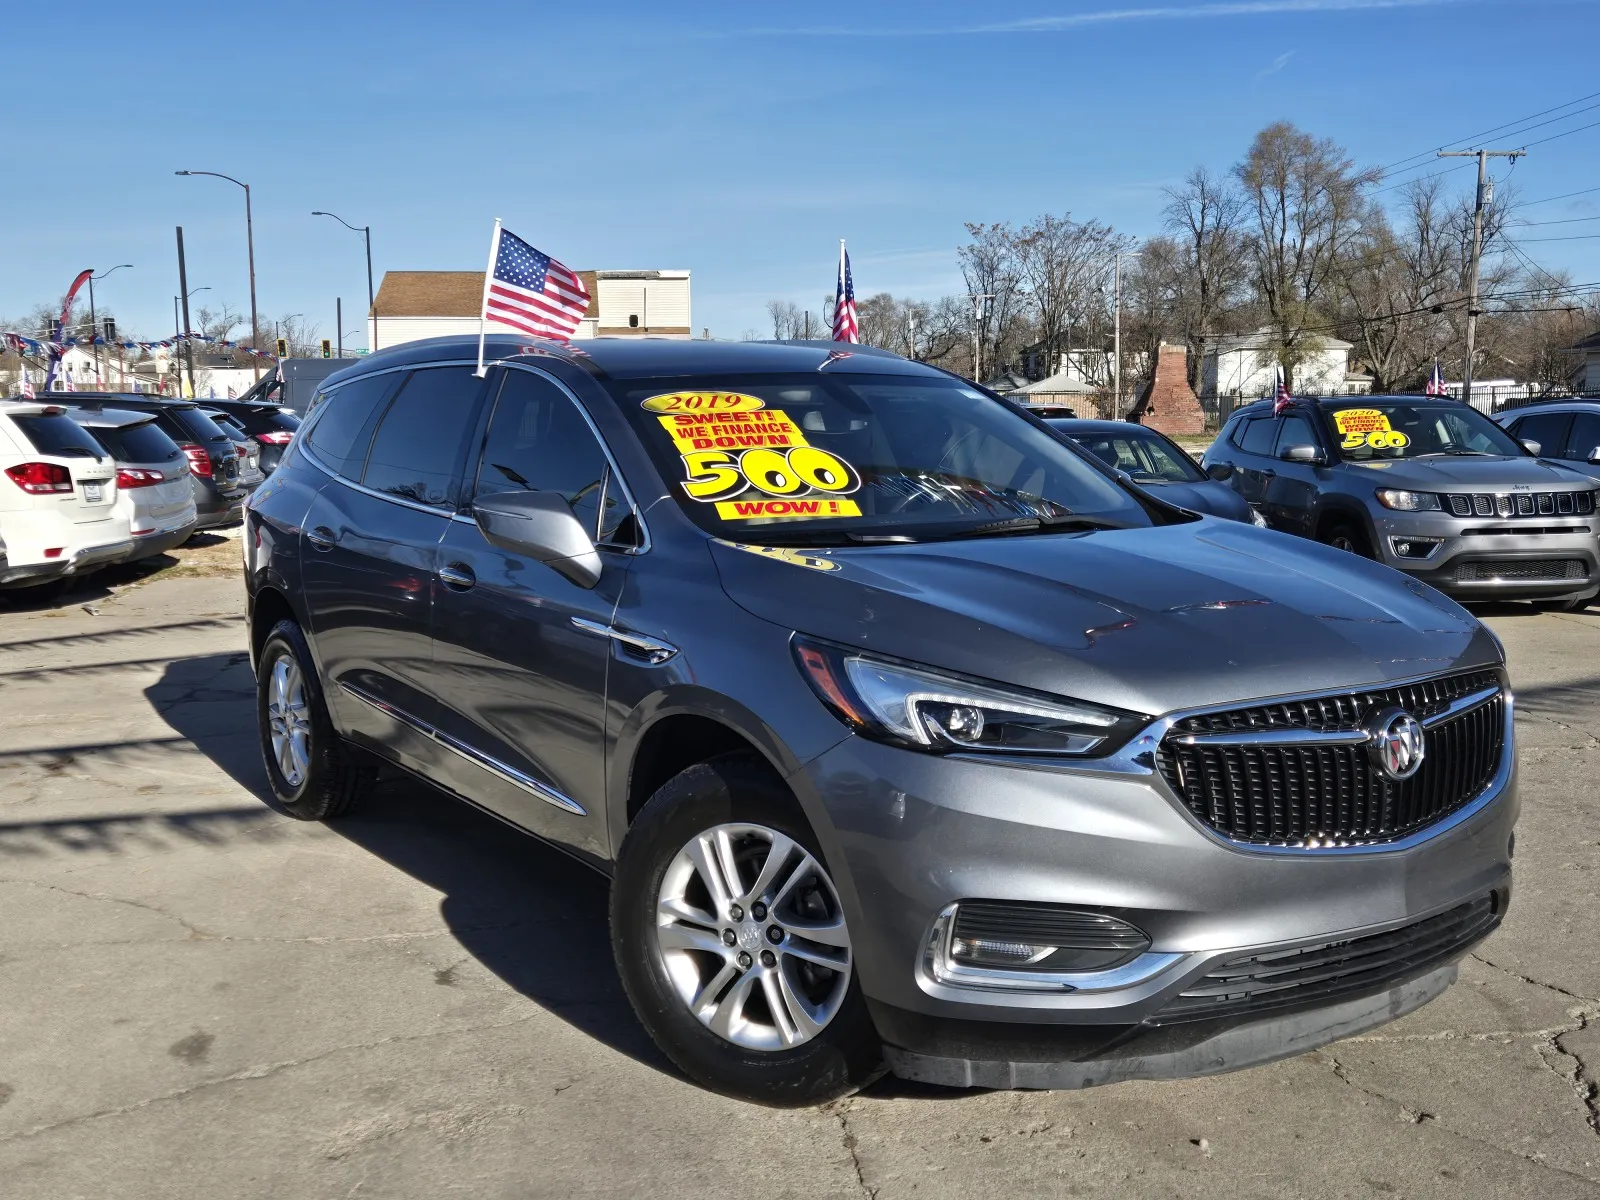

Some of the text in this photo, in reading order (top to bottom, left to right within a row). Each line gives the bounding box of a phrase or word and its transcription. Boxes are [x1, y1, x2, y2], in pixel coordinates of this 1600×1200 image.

[665, 394, 742, 411] 2019
[673, 410, 776, 426] SWEET!
[676, 423, 792, 439] WE FINANCE
[692, 434, 790, 450] DOWN
[1341, 430, 1411, 449] 500
[680, 446, 862, 502] 500
[734, 501, 822, 516] WOW
